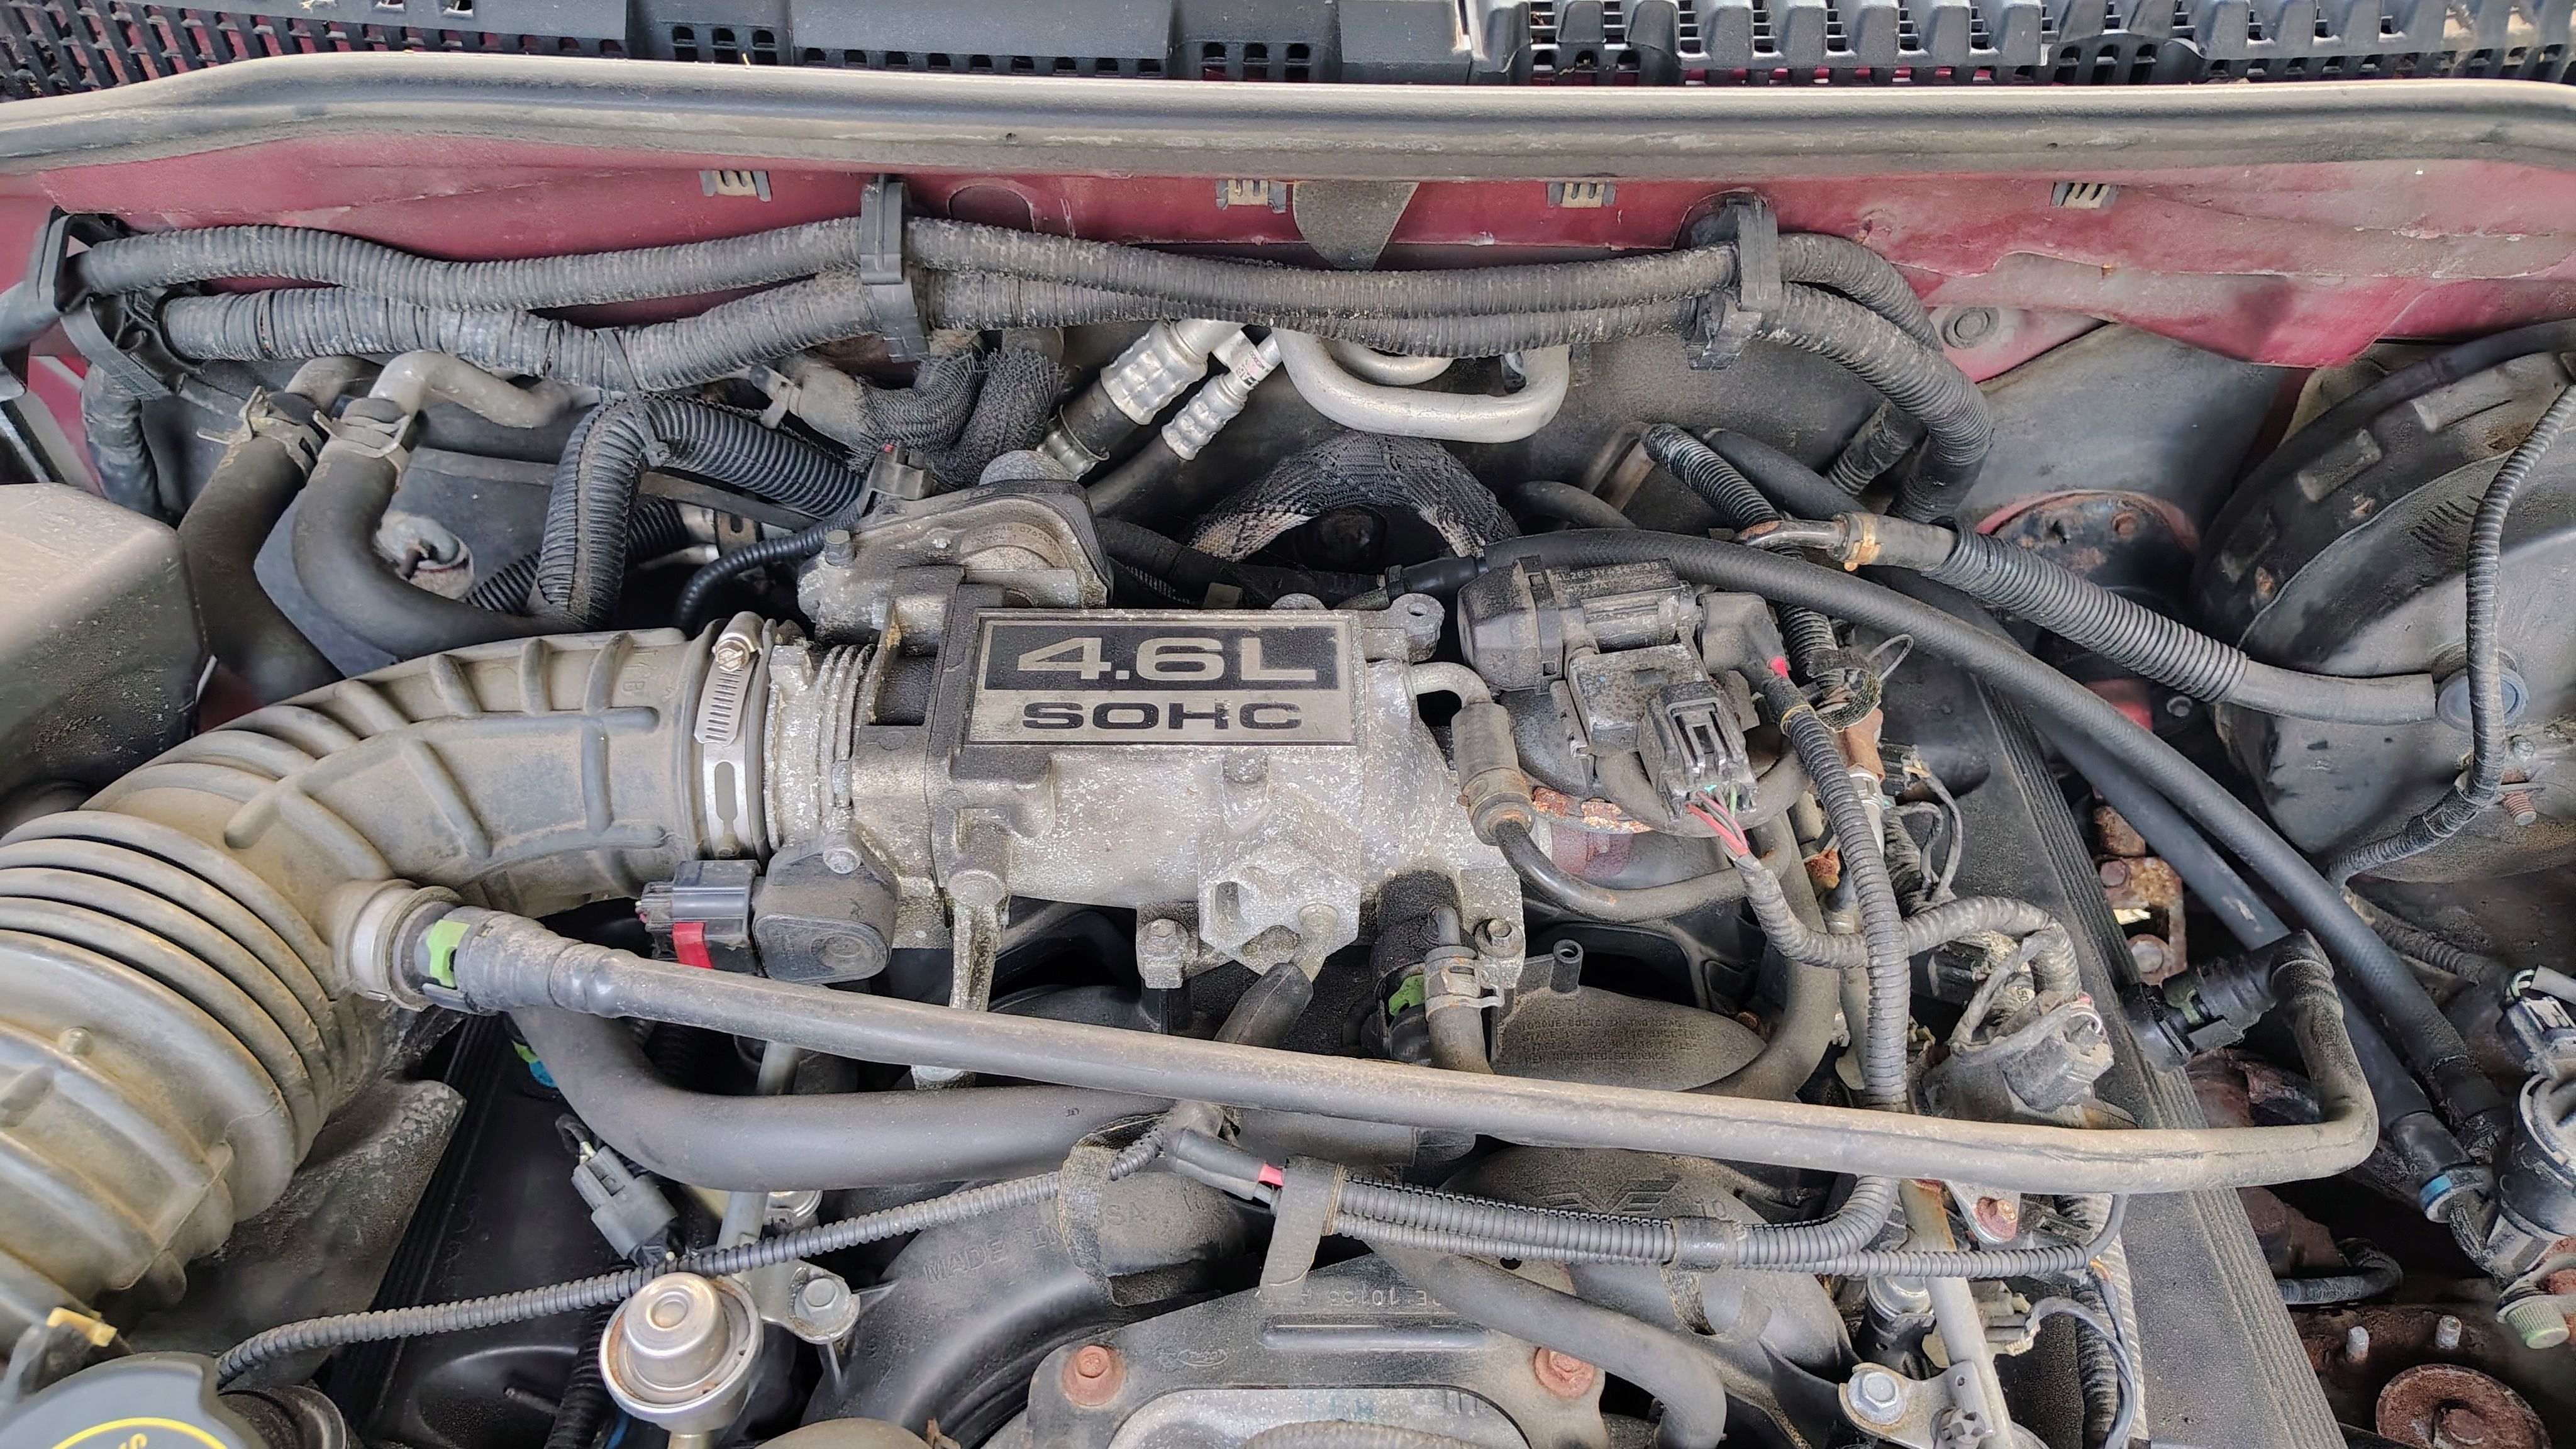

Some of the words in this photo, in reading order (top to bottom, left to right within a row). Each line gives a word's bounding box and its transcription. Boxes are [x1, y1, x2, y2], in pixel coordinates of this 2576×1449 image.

[1017, 636, 1317, 682] 4.6L
[1022, 701, 1303, 731] SOHC
[923, 1237, 1007, 1284] MADE
[1098, 1201, 1148, 1226] SA
